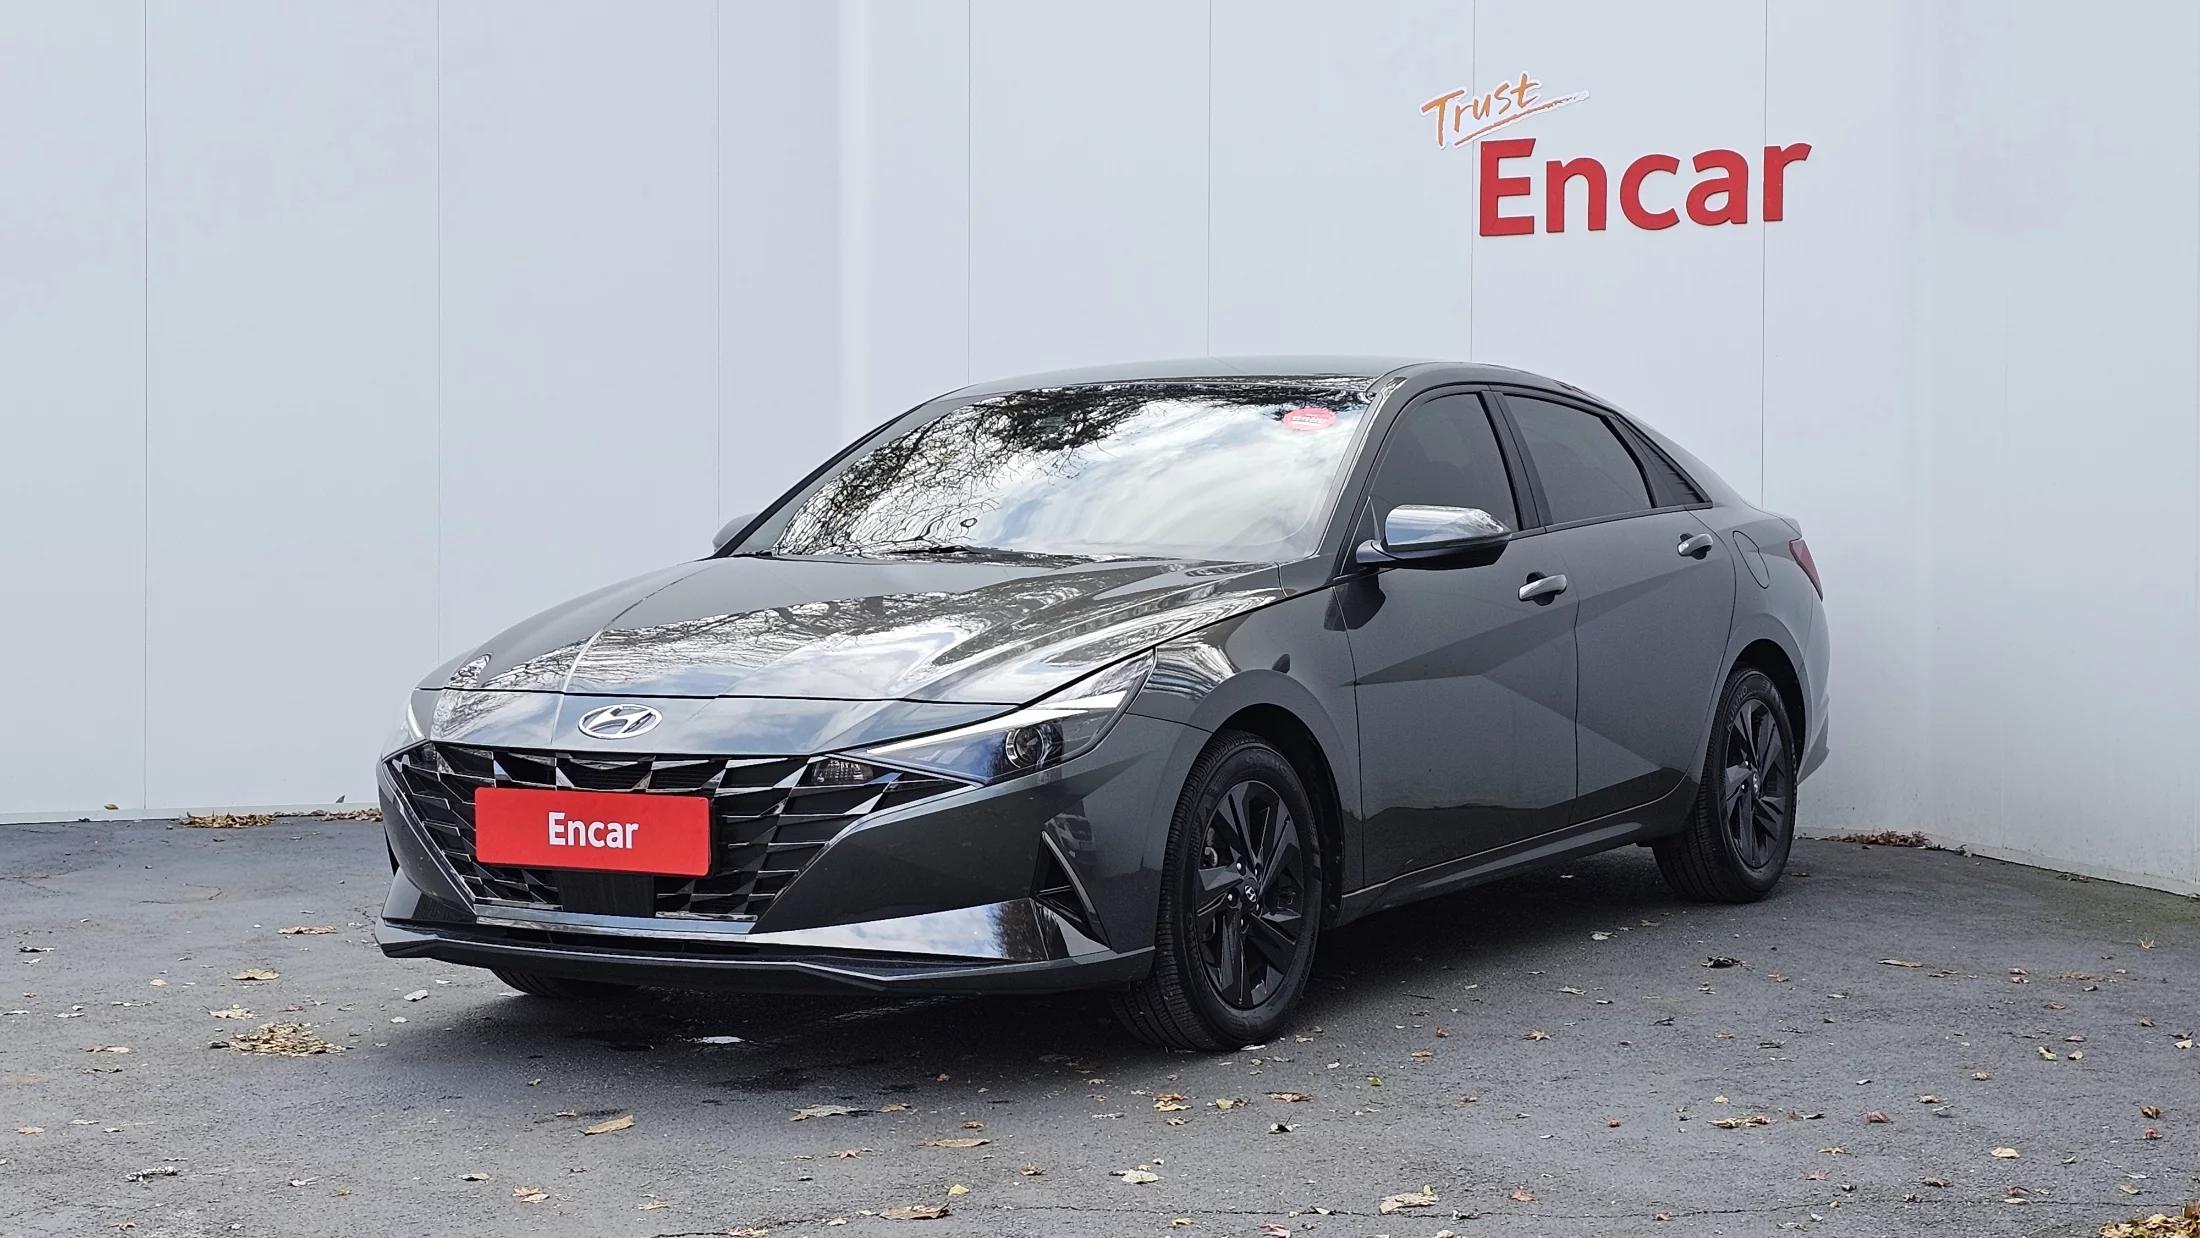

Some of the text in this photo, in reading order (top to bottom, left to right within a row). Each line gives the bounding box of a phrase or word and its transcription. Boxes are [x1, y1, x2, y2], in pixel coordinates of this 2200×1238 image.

[1420, 72, 1541, 146] Trust
[1479, 138, 1812, 237] Encar
[548, 811, 639, 849] Encar
